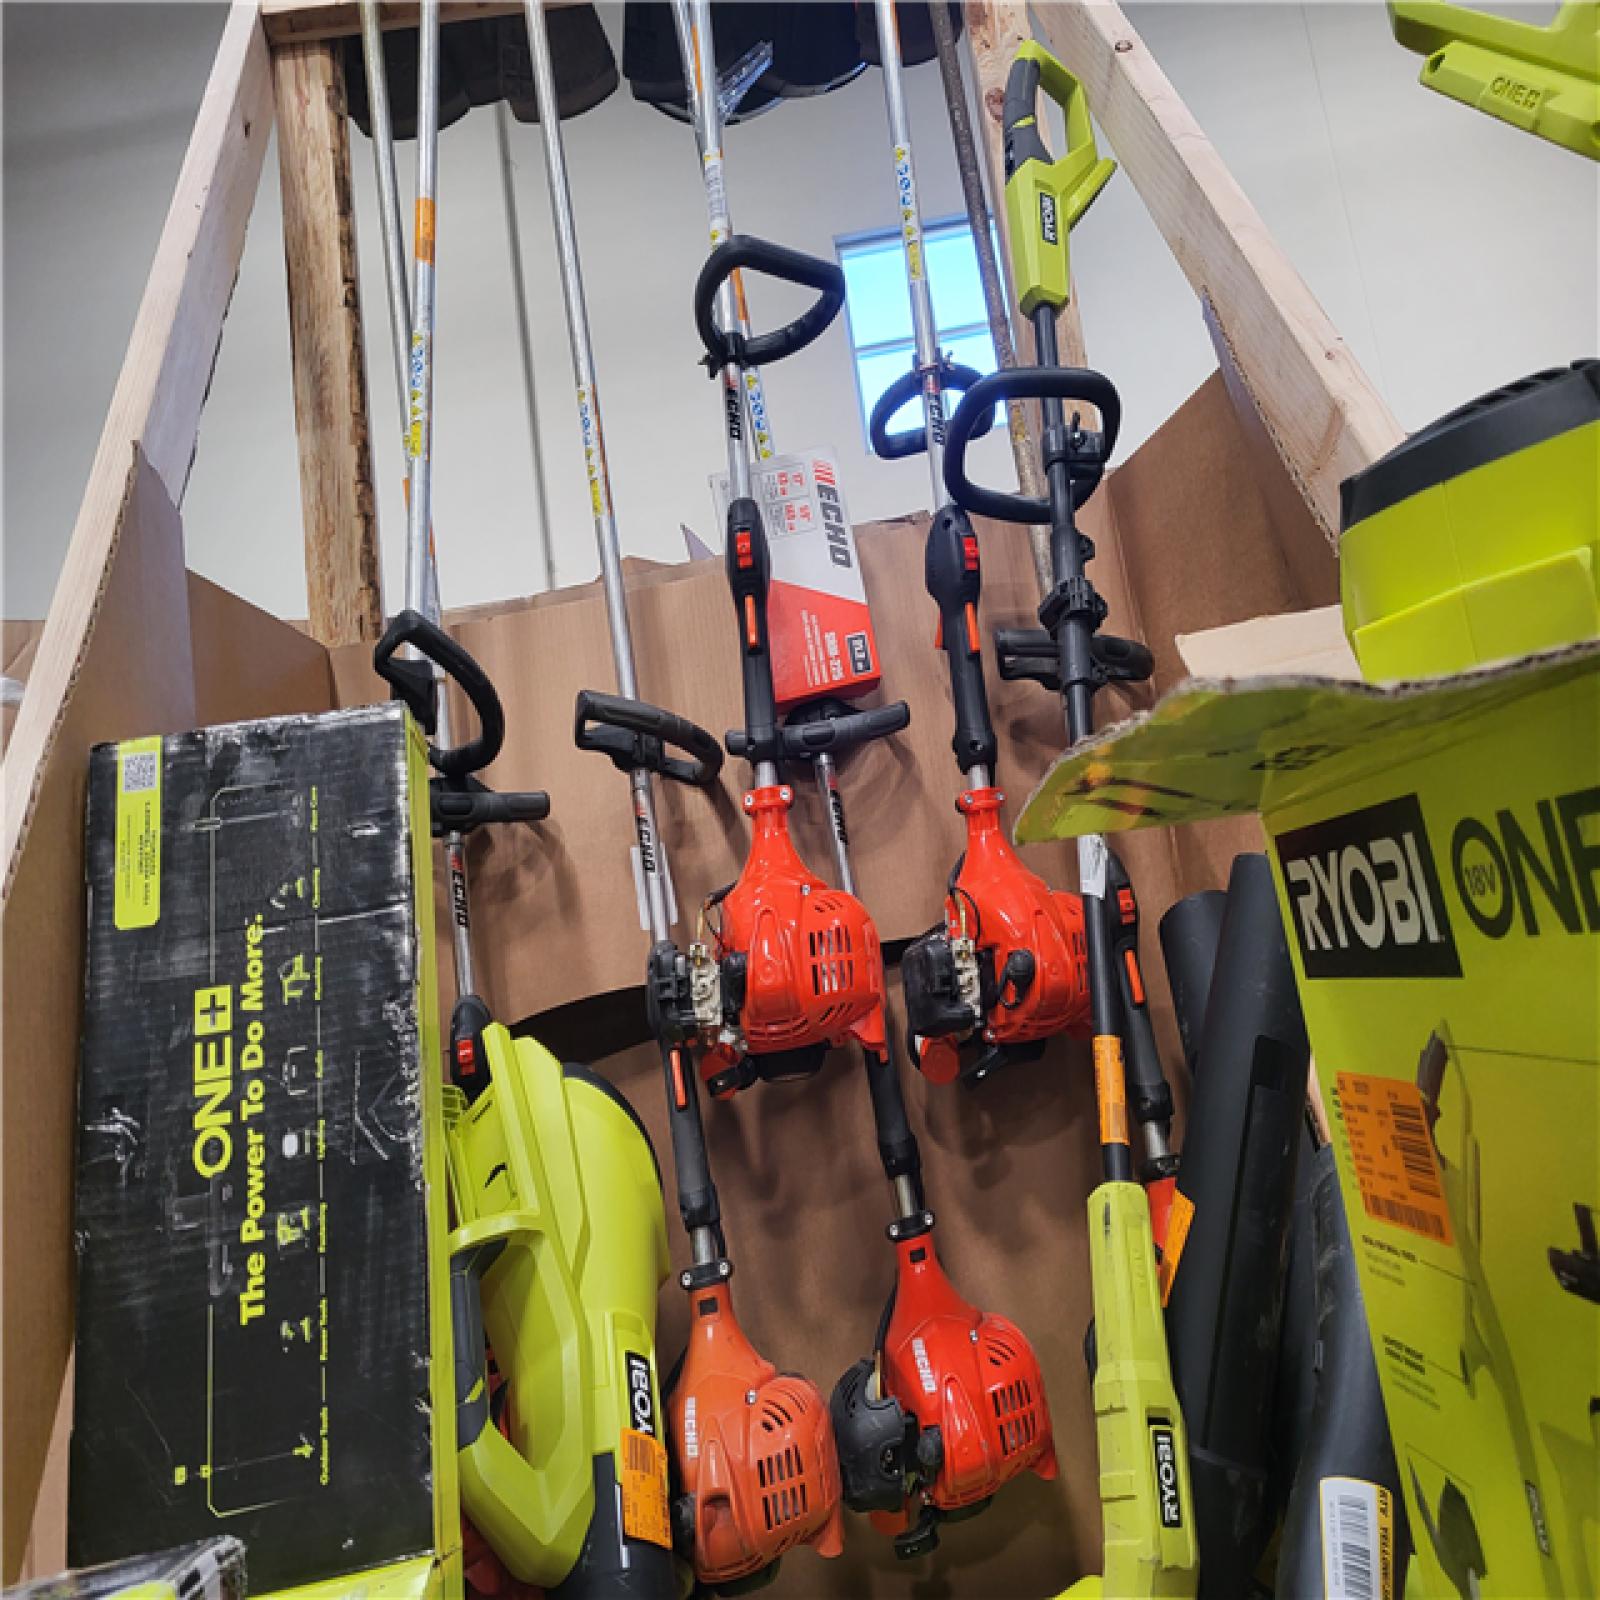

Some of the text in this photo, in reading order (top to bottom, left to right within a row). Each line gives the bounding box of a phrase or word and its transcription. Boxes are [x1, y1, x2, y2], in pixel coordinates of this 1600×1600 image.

[816, 483, 852, 569] ECHO
[453, 869, 469, 928] ECHO
[1286, 831, 1443, 951] RYOBI
[1465, 863, 1496, 897] 18V
[240, 1019, 264, 1071] Do
[240, 1078, 264, 1122] To
[240, 1127, 265, 1243] Power
[240, 1251, 265, 1326] The
[1156, 1435, 1179, 1524] RYOBI
